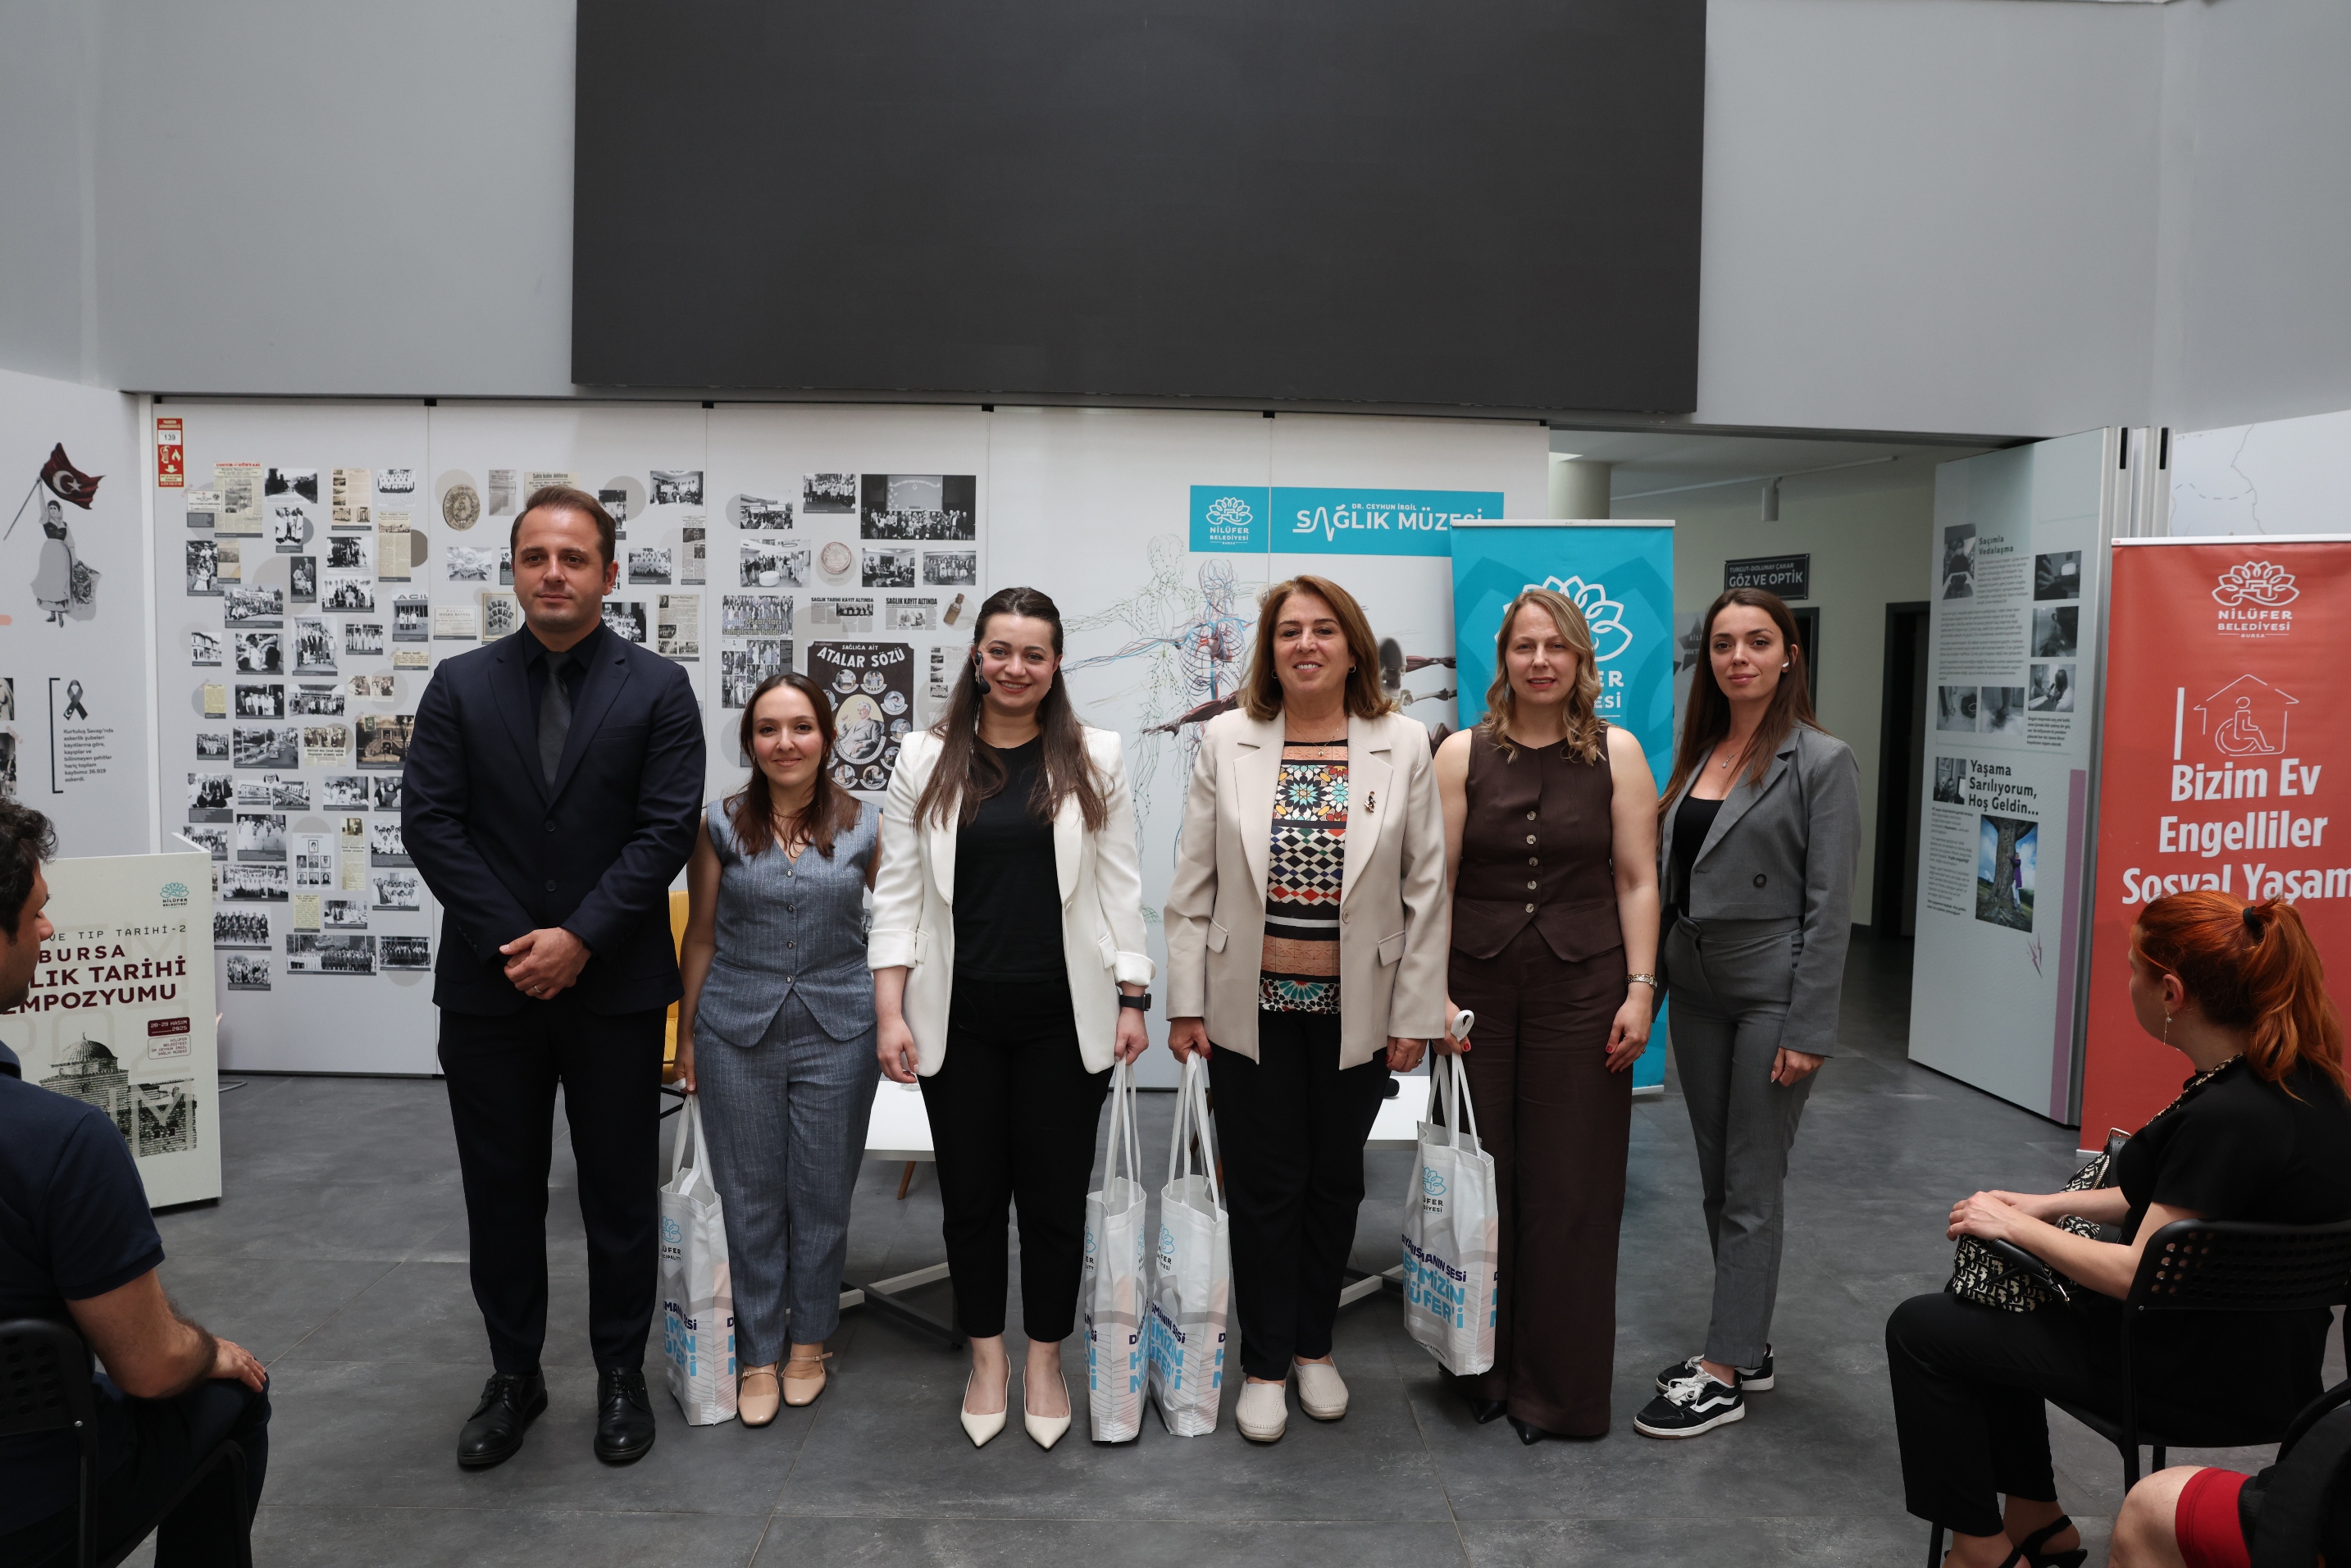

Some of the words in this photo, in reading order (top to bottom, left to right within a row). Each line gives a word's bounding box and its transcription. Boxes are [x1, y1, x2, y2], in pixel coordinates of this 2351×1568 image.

[1210, 525, 1249, 534] NİLÜFER
[1979, 535, 2004, 546] Saçımla
[1979, 546, 2014, 555] Vedalaşma
[1729, 573, 1751, 587] GÖZ
[1752, 574, 1767, 586] VE
[1769, 569, 1803, 585] OPTİK
[2218, 608, 2293, 620] NİLÜFER
[761, 627, 781, 636] buldu
[2217, 621, 2291, 631] BELEDİYESİ
[817, 646, 865, 668] ATALAR
[871, 646, 905, 668] SÖZÜ
[1971, 759, 2012, 777] Yaşama
[1969, 776, 2037, 800] Sarılıyorum,
[2171, 761, 2269, 802] Bizim
[2279, 758, 2322, 796] Ev
[1969, 793, 1989, 812] Hoş
[1992, 796, 2039, 815] Geldin...
[2158, 810, 2329, 859] Engelliler
[78, 930, 104, 940] TIP
[39, 945, 125, 964] BURSA
[30, 969, 80, 988] LIK
[89, 955, 186, 982] TARİHİ
[2, 983, 176, 1015] MPOZYUMU
[1423, 1194, 1444, 1206] ÜFER
[1423, 1205, 1442, 1214] İYESİ
[662, 1245, 681, 1256] ÜFER
[1401, 1233, 1446, 1271] AYANIŞMANIN
